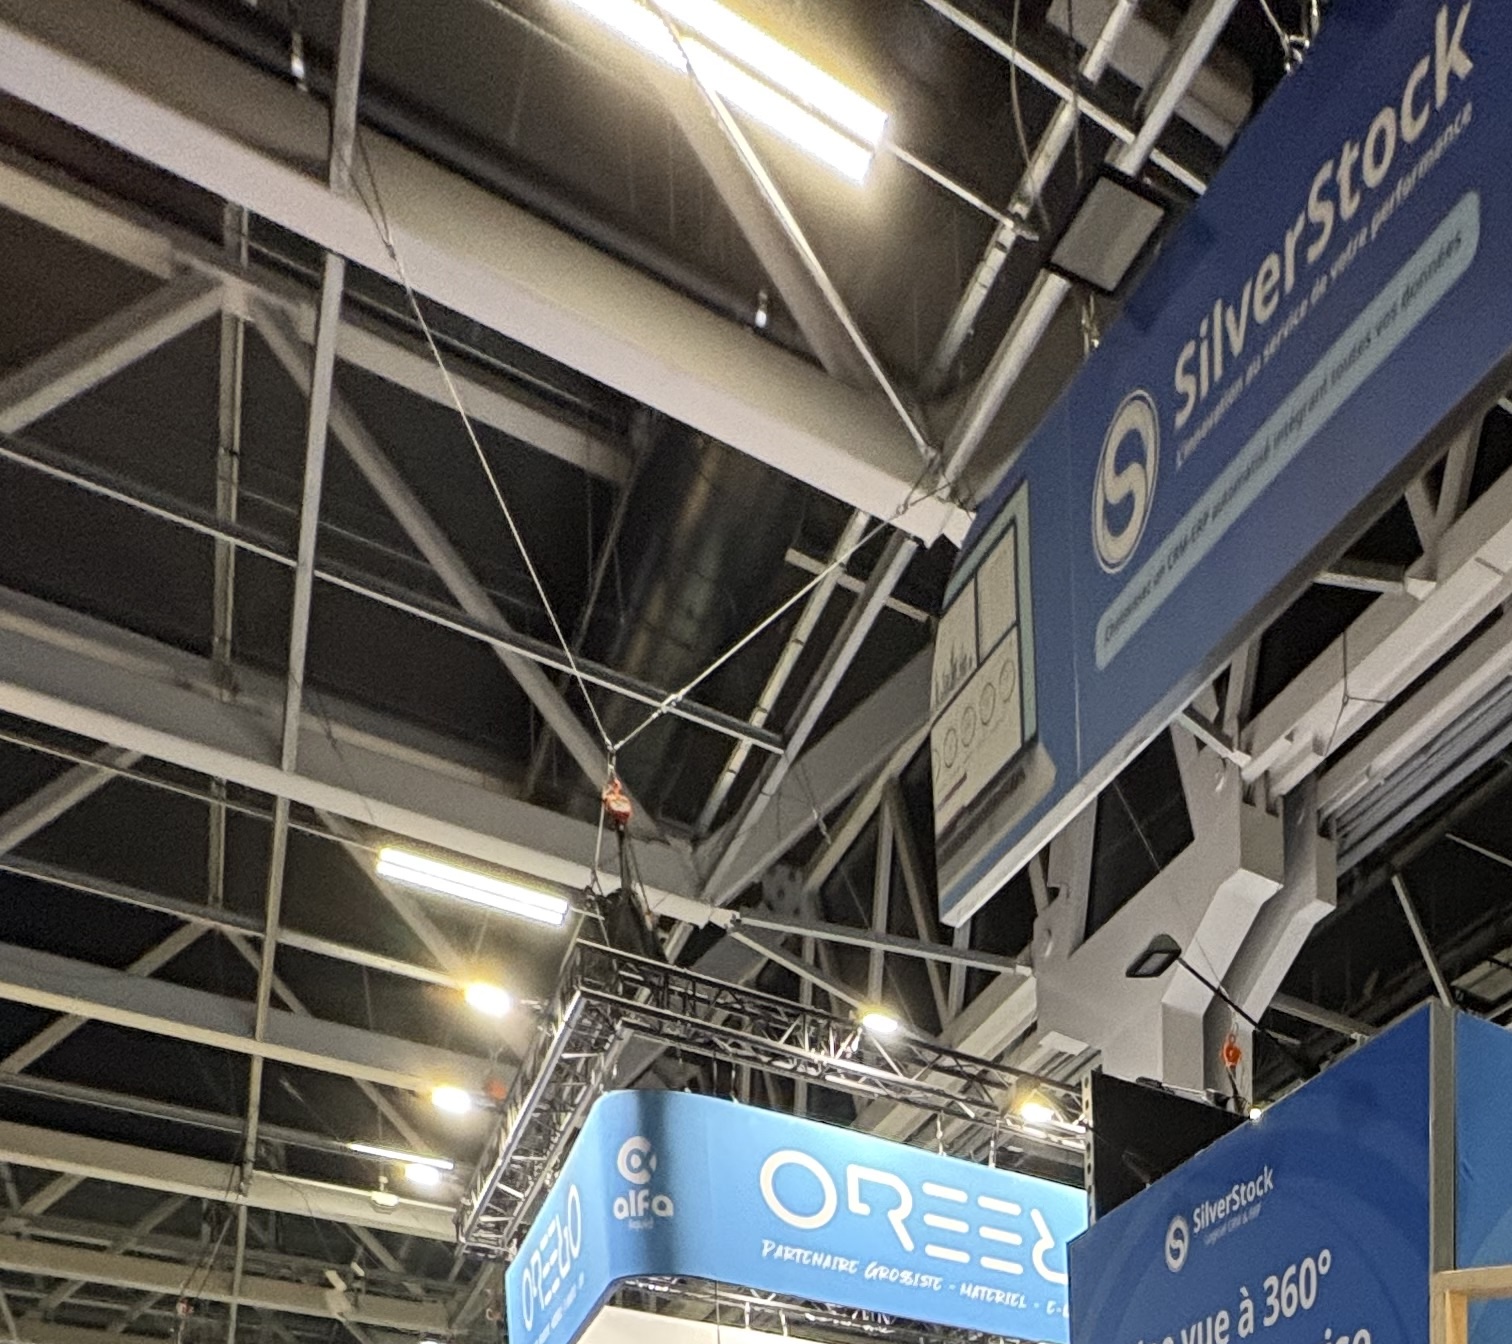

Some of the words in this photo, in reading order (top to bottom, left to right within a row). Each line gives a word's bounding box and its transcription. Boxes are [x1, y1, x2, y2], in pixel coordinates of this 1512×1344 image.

[1174, 0, 1473, 430] SilverStock
[613, 1189, 674, 1220] alfa
[1192, 1163, 1274, 1234] SilverStock
[1237, 1285, 1254, 1339] à
